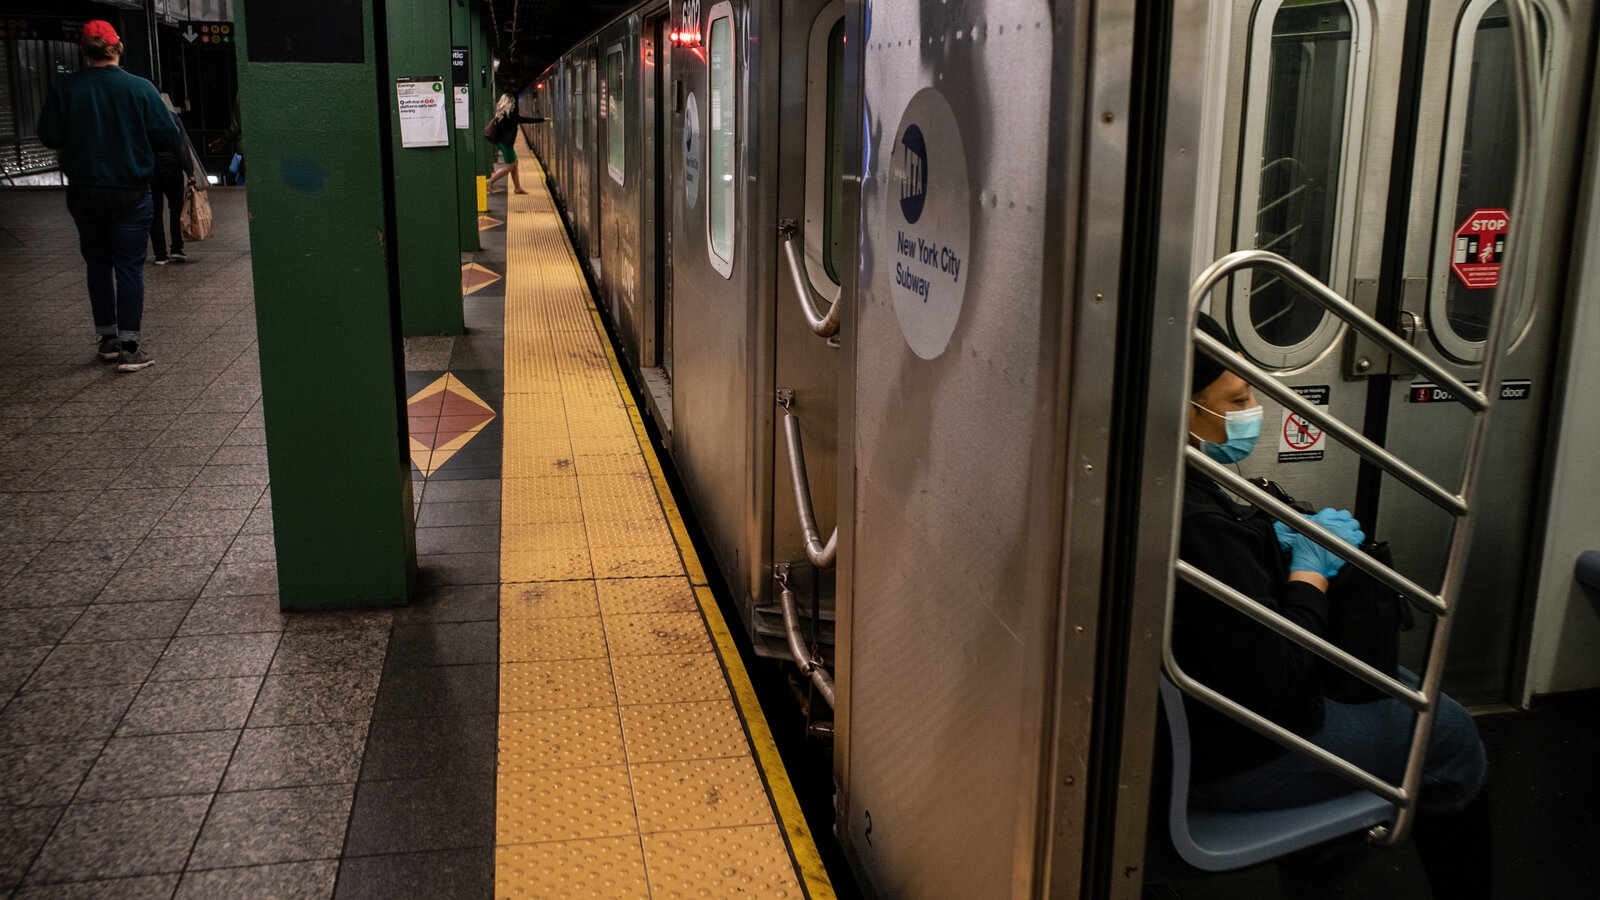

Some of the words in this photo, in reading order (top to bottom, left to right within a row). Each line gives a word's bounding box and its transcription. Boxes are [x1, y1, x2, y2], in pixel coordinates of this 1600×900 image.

[1471, 219, 1506, 231] STOP
[897, 230, 916, 258] New
[918, 237, 939, 269] York
[940, 246, 961, 283] City
[896, 262, 930, 303] Subway
[1501, 387, 1526, 397] door
